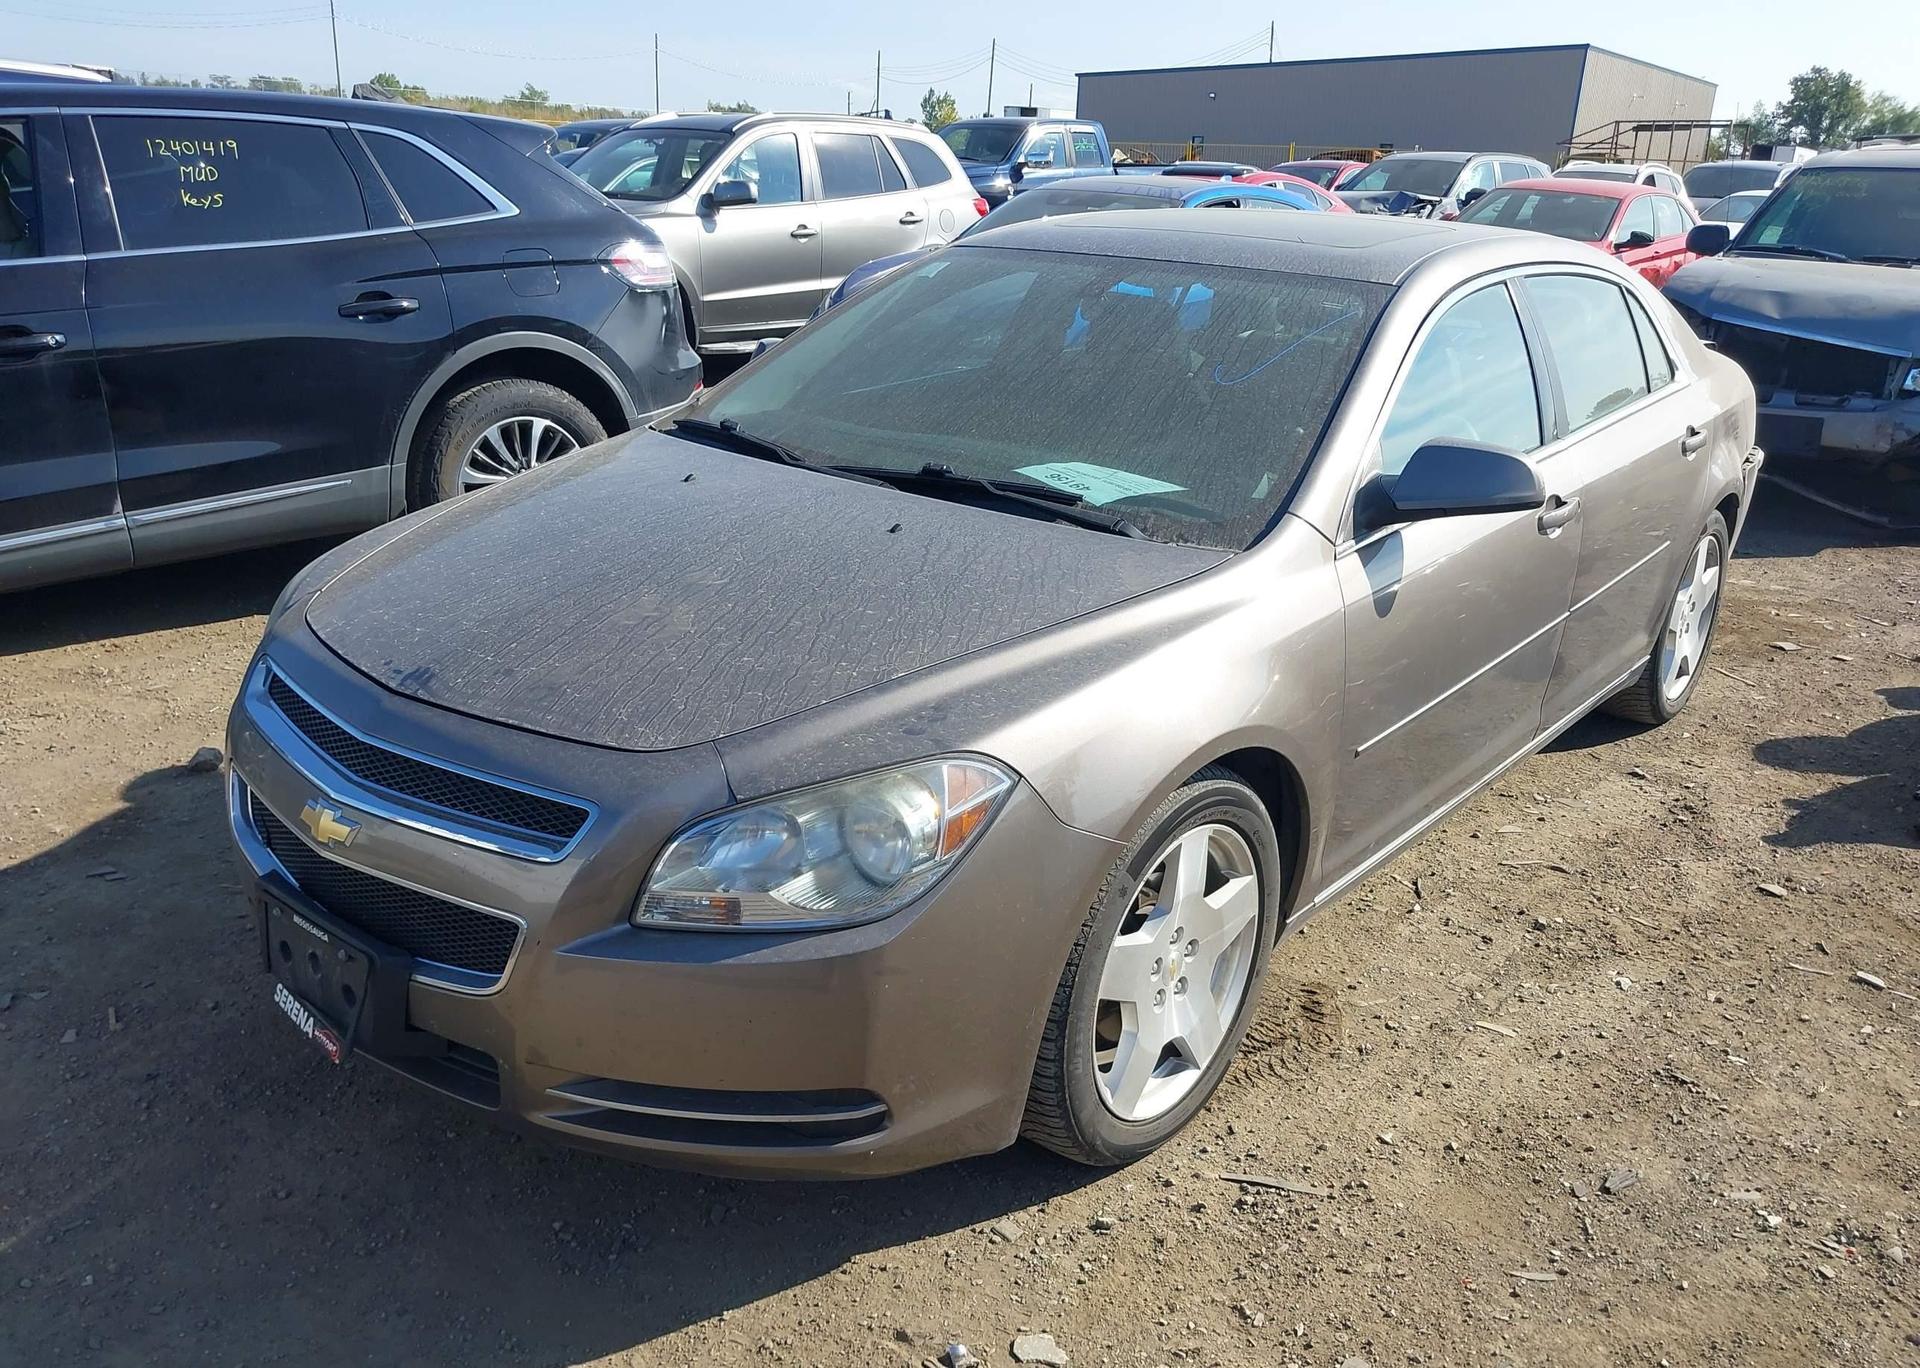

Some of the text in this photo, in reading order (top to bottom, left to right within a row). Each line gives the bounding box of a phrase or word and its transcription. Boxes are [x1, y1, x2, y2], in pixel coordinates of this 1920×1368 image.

[146, 139, 239, 160] 12401419
[293, 914, 329, 943] MISSISSAUGA
[273, 982, 314, 1039] SERENA
